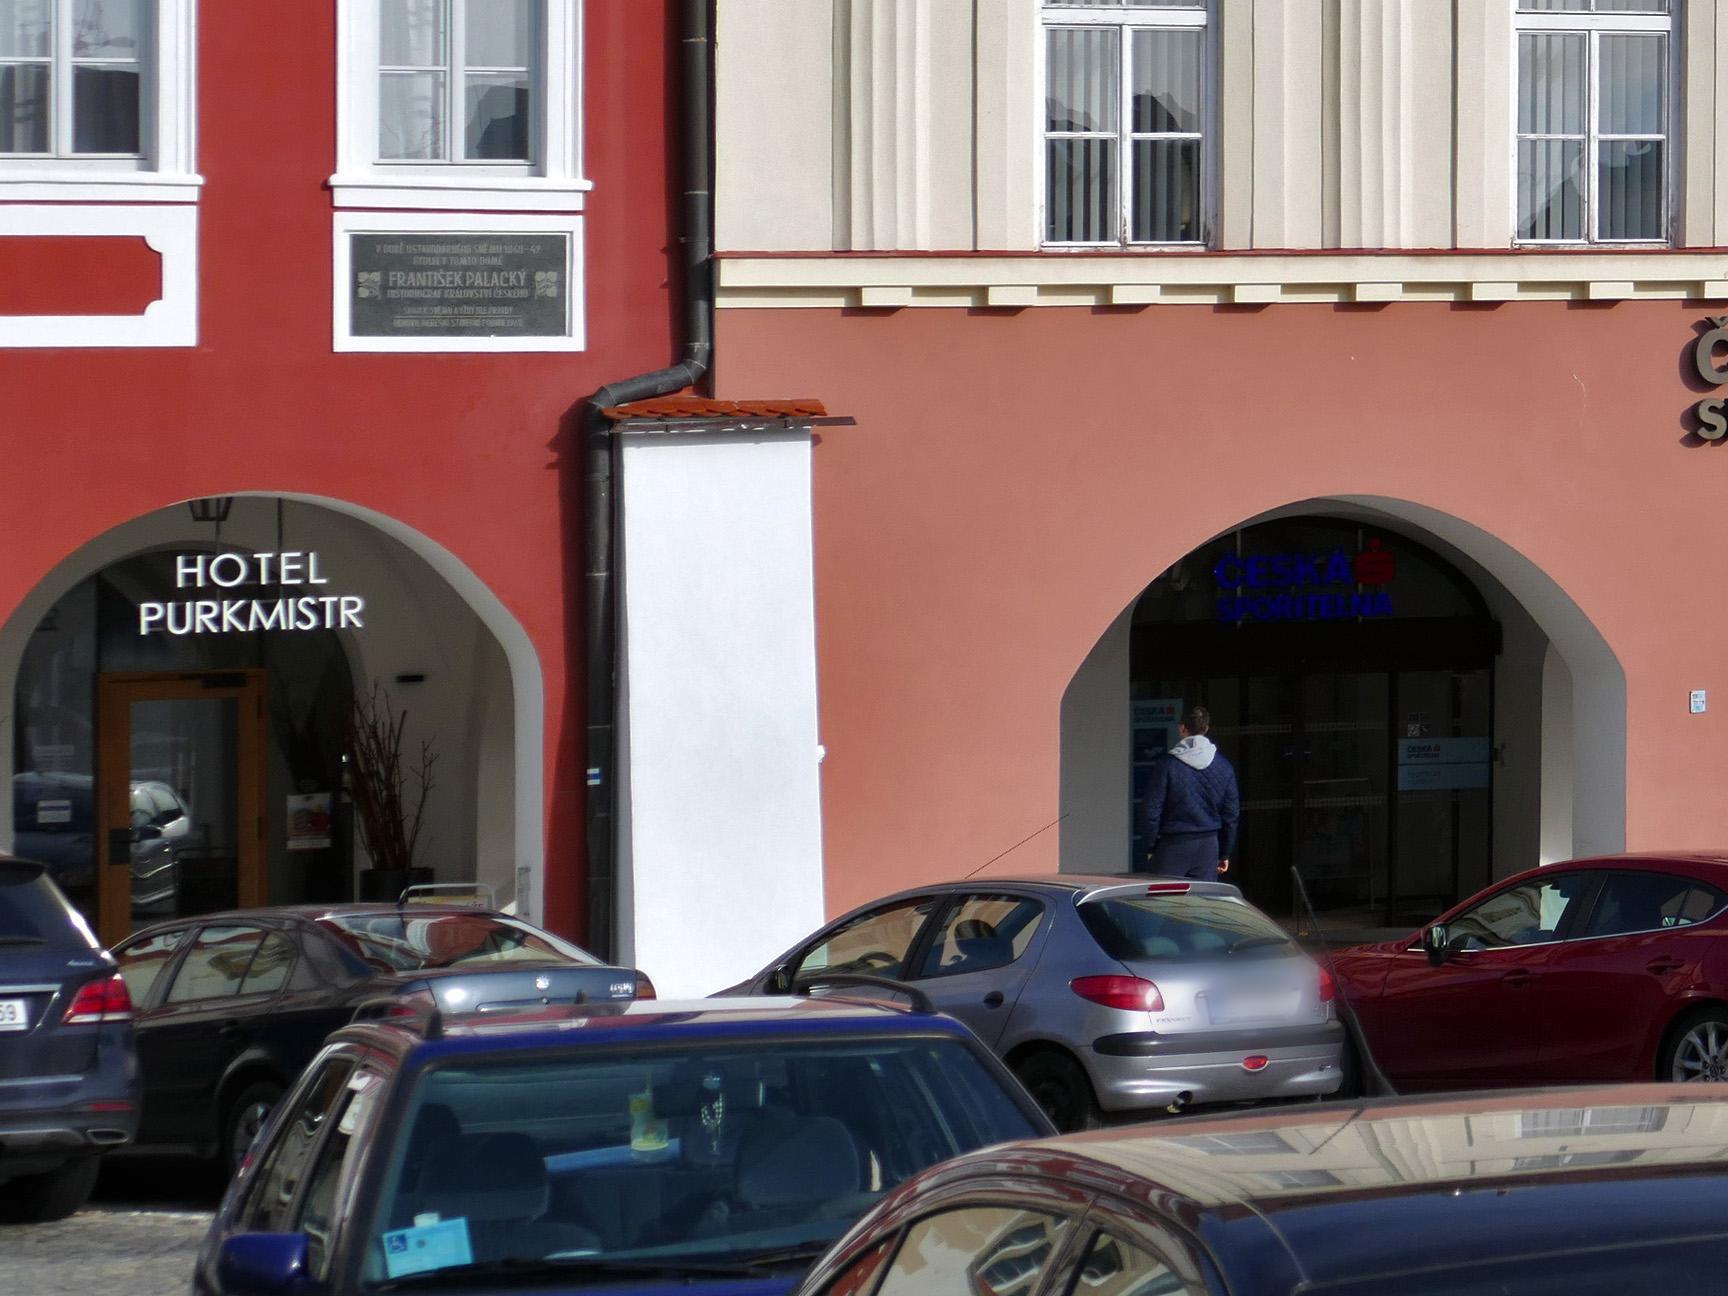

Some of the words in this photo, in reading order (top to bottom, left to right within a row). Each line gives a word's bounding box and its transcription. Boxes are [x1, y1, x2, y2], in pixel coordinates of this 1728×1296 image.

[389, 269, 464, 287] FRANTIŠEK
[466, 269, 526, 287] PALACKÝ
[176, 552, 329, 588] HOTEL
[139, 596, 365, 636] PURKMISTR
